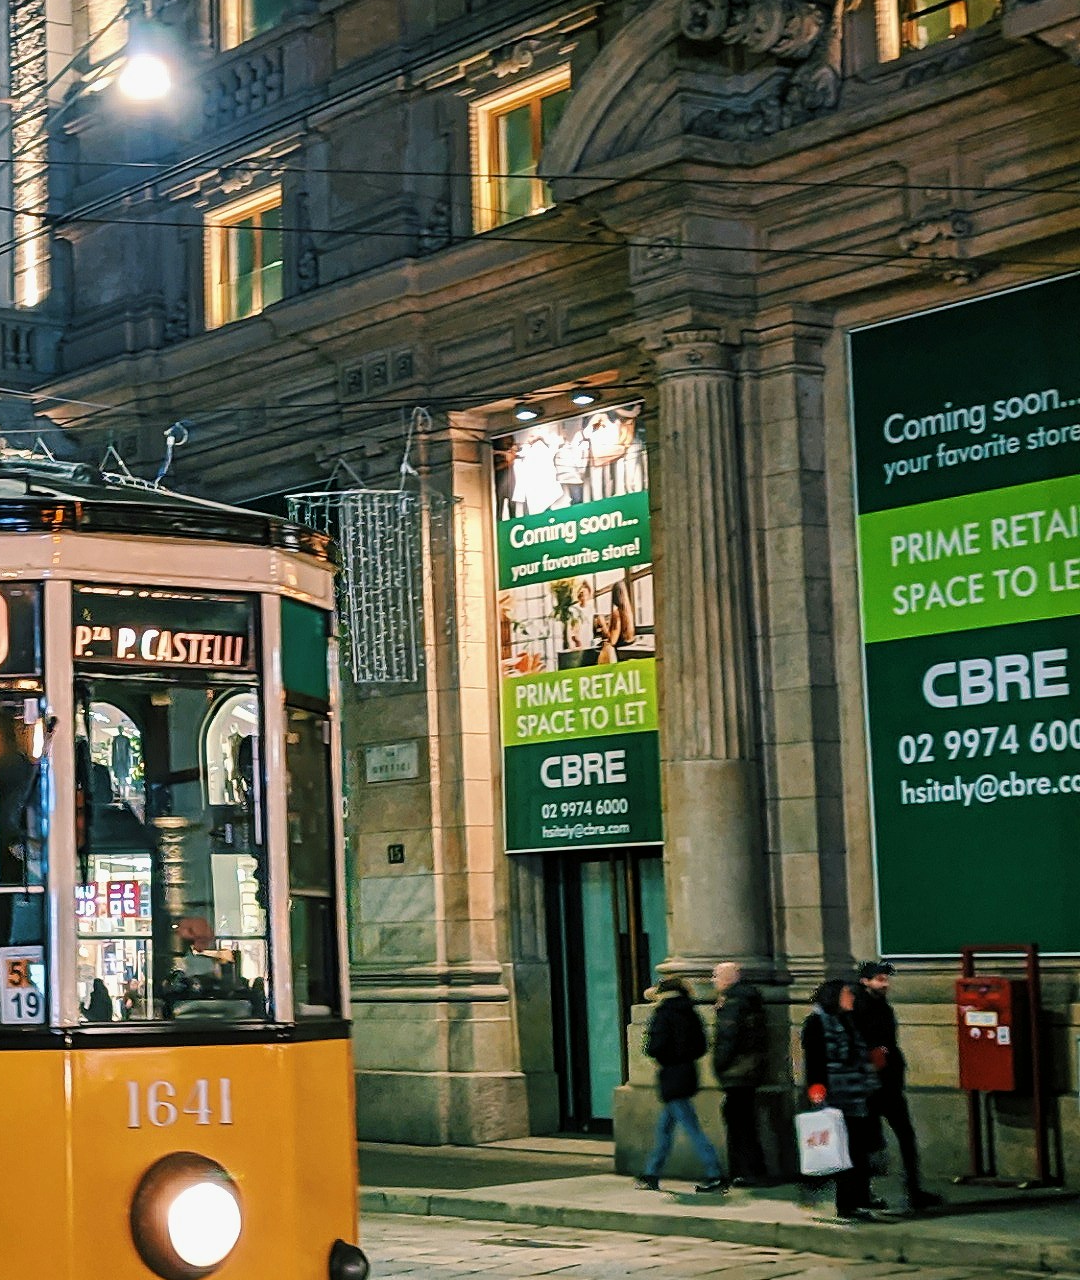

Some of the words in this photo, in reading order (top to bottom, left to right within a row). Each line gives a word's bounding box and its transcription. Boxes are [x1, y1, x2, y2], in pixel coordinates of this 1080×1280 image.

[883, 401, 986, 444] Coming
[992, 388, 1080, 422] soon...
[883, 453, 933, 485] your
[936, 433, 1021, 468] favorite
[510, 517, 577, 549] Coming
[580, 511, 639, 535] soon...
[890, 522, 981, 568] PRIME
[991, 504, 1080, 551] RETAI
[511, 561, 541, 582] your
[542, 547, 600, 572] favourite
[602, 537, 640, 561] store!
[892, 573, 984, 616] SPACE
[992, 565, 1038, 600] TO
[1049, 558, 1080, 592] LE
[516, 678, 573, 708] PRIME
[580, 669, 646, 700] RETAIL
[922, 648, 1070, 709] CBRE
[516, 709, 576, 738] SPACE
[580, 705, 609, 730] TO
[615, 701, 647, 726] LET
[898, 733, 935, 765] 02
[944, 724, 1020, 761] 9974
[1029, 718, 1080, 754] 600
[540, 749, 627, 789] CBRE
[900, 771, 1080, 807] hsitaly@cbre.co
[541, 803, 558, 819] 02
[560, 800, 593, 818] 9974
[595, 798, 628, 815] 6000
[542, 822, 630, 839] hsitaly@cbre.com
[11, 992, 39, 1018] 19
[126, 1077, 233, 1128] 1641
